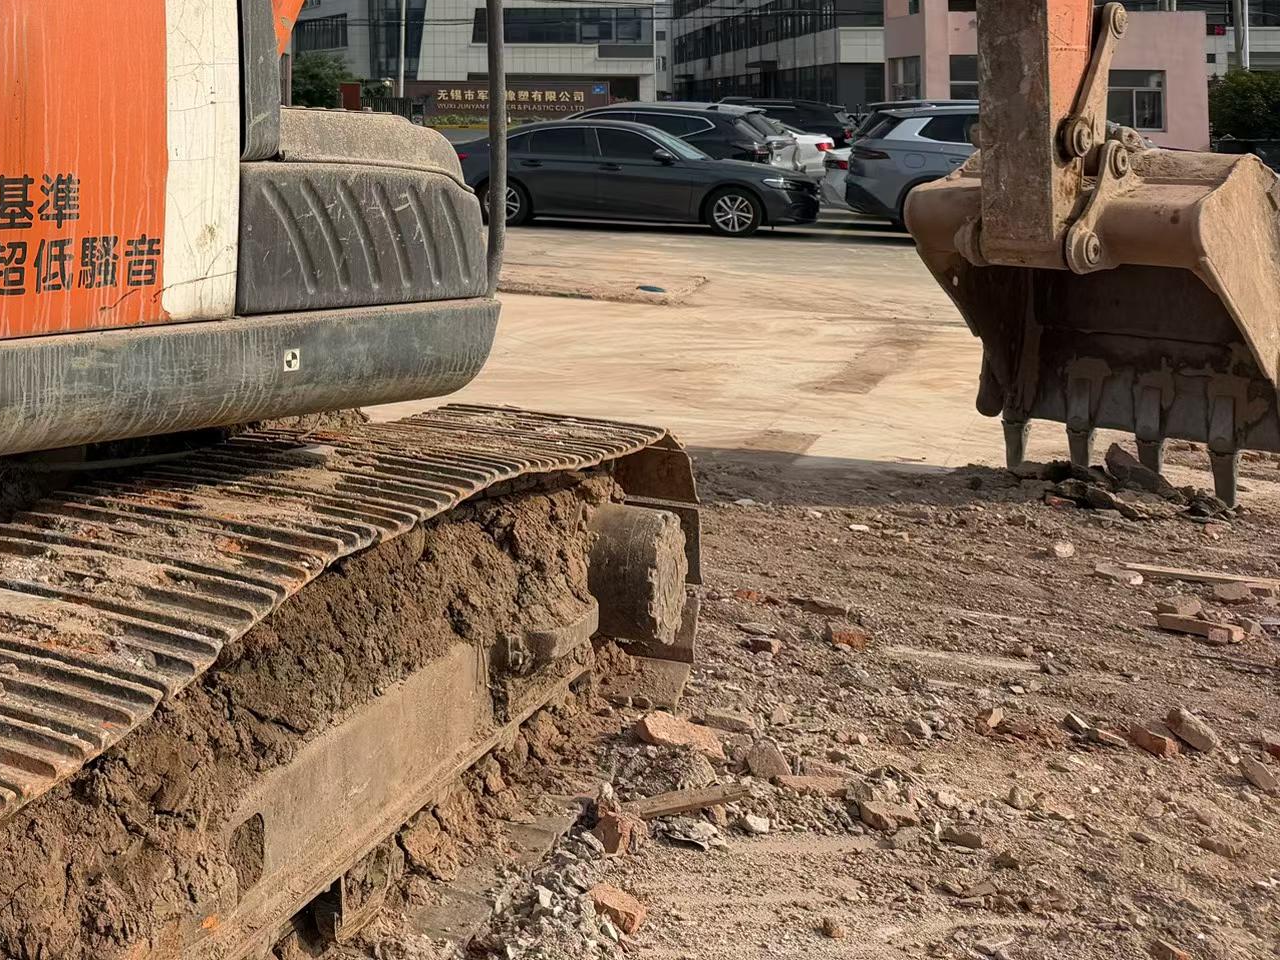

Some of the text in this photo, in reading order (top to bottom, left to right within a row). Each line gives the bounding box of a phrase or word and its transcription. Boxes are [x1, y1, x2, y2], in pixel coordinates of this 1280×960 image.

[437, 89, 584, 102] 无锡市军橡塑有限公司
